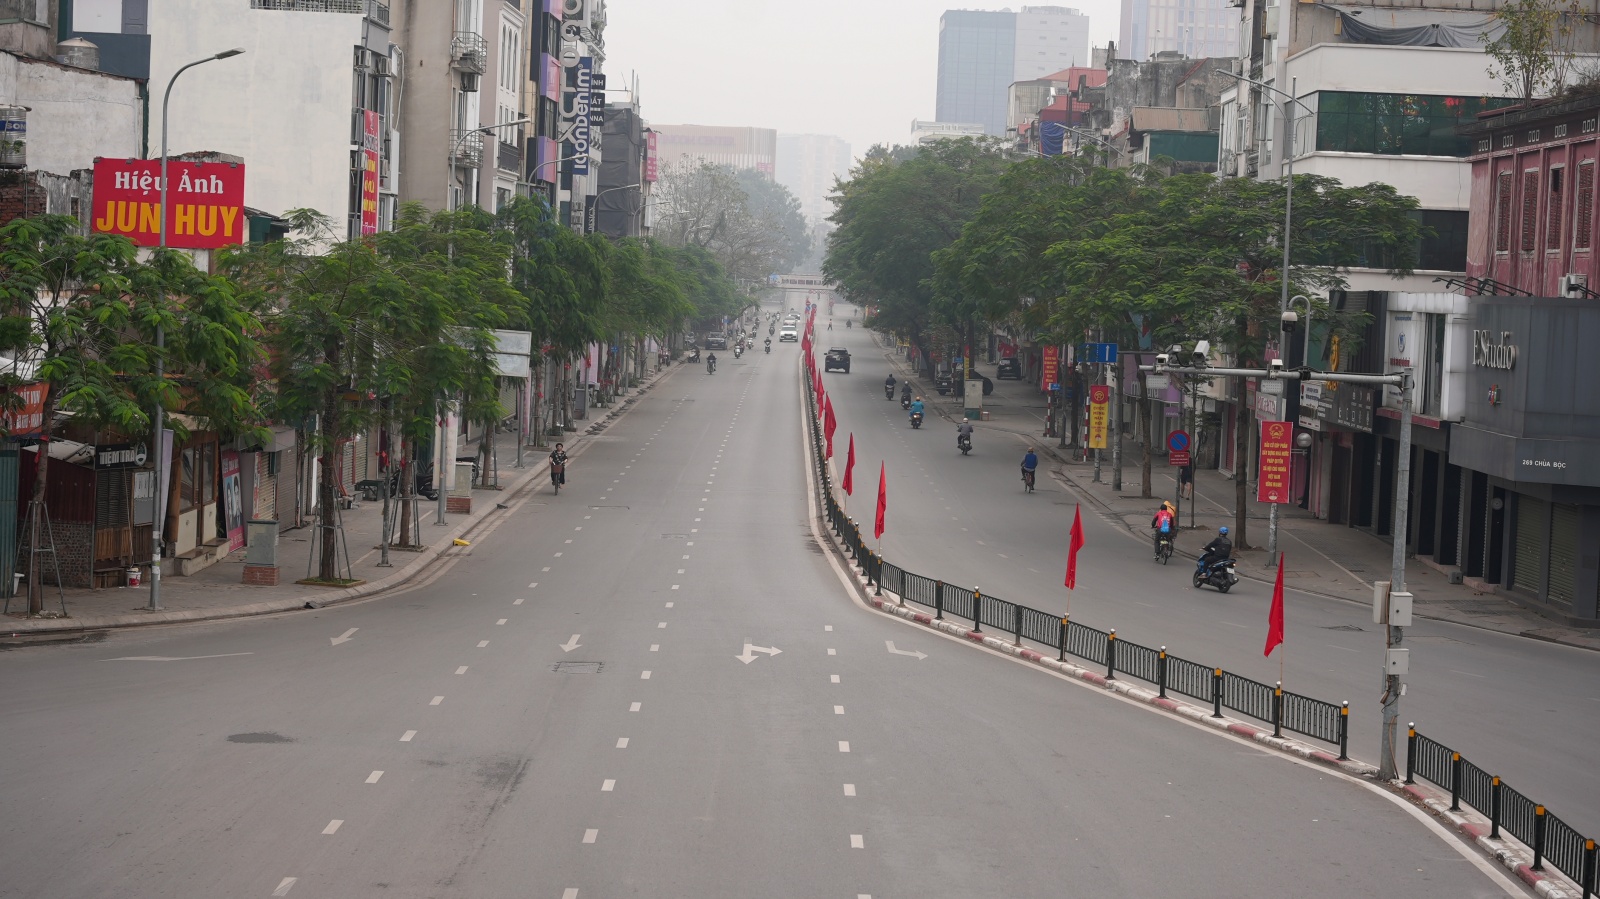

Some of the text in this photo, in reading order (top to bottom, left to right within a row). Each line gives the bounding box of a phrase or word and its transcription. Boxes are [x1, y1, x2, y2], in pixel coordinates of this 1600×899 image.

[115, 168, 224, 196] Hiệu Ảnh
[96, 200, 239, 237] JUN HUY
